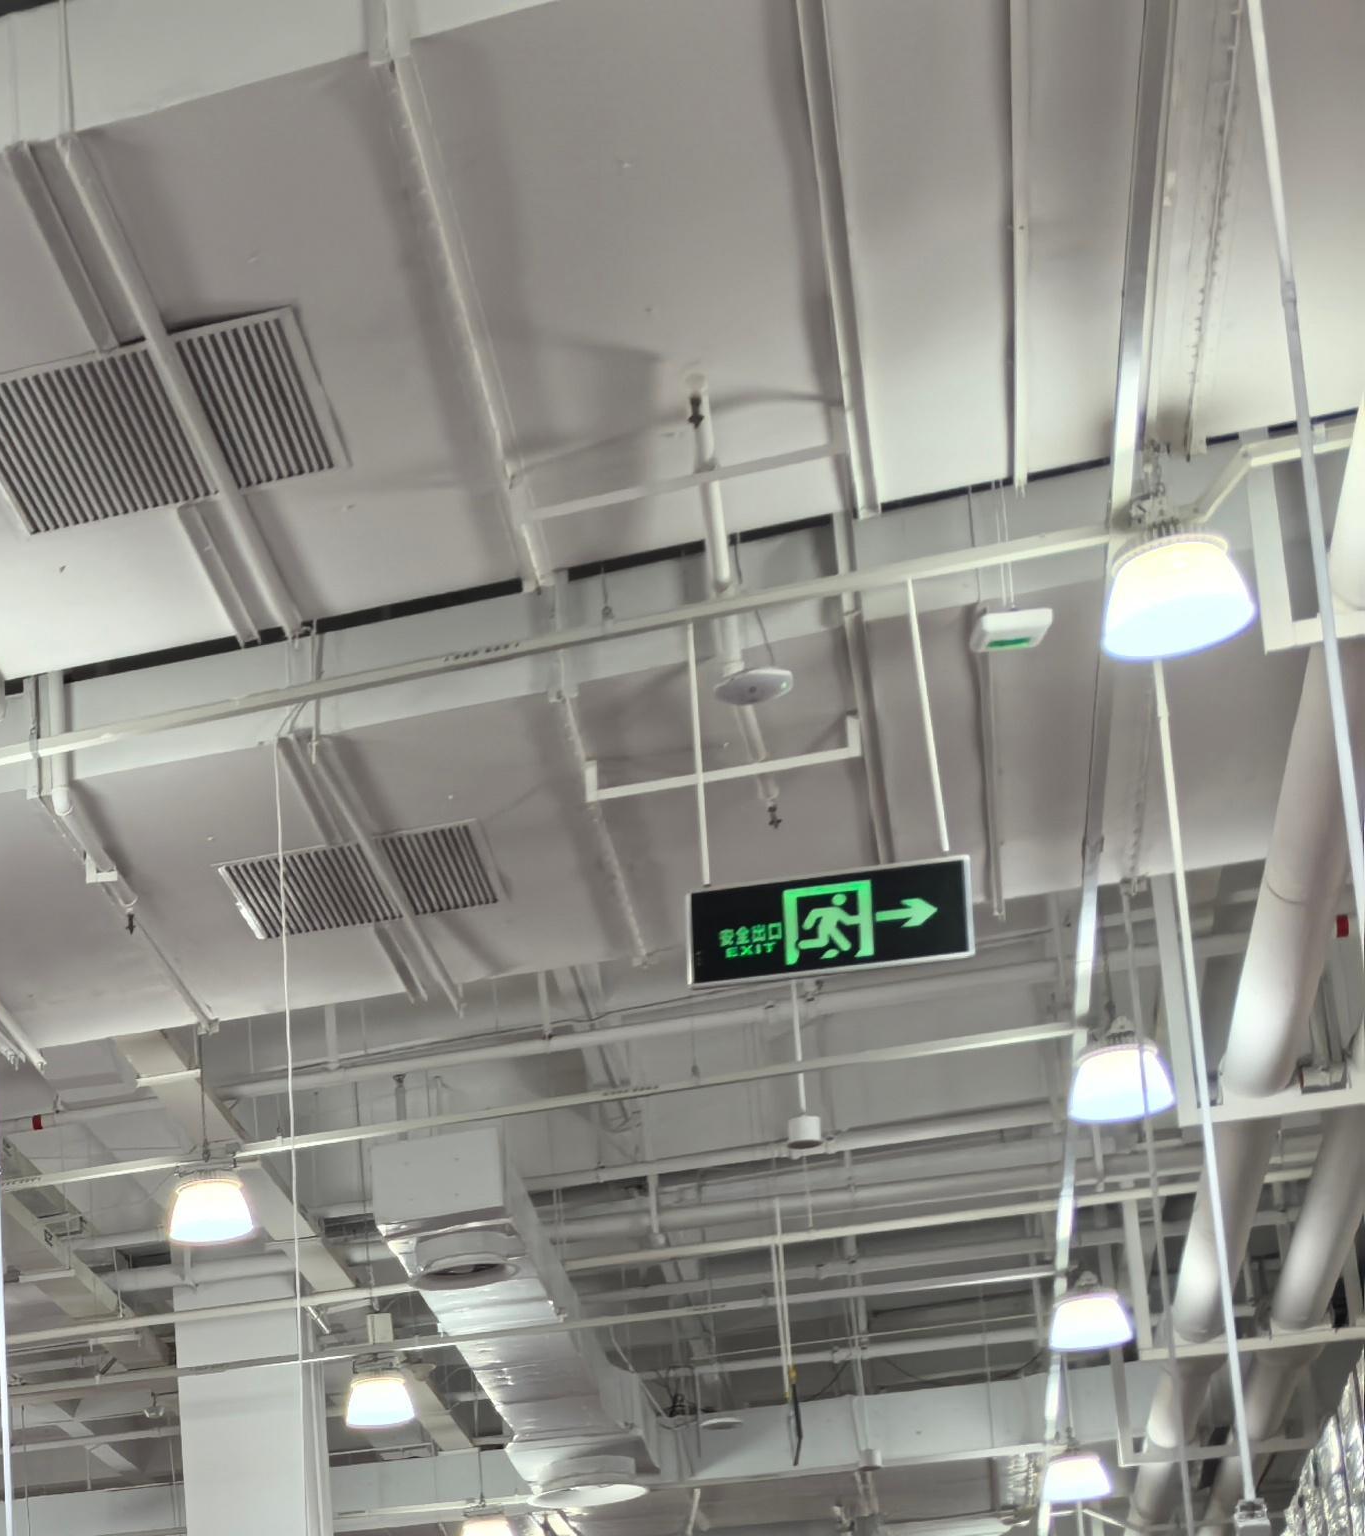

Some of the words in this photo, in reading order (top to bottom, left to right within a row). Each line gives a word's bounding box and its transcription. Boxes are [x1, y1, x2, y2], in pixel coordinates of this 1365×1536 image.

[717, 921, 783, 948] 安全出口
[724, 943, 779, 959] EXIT
